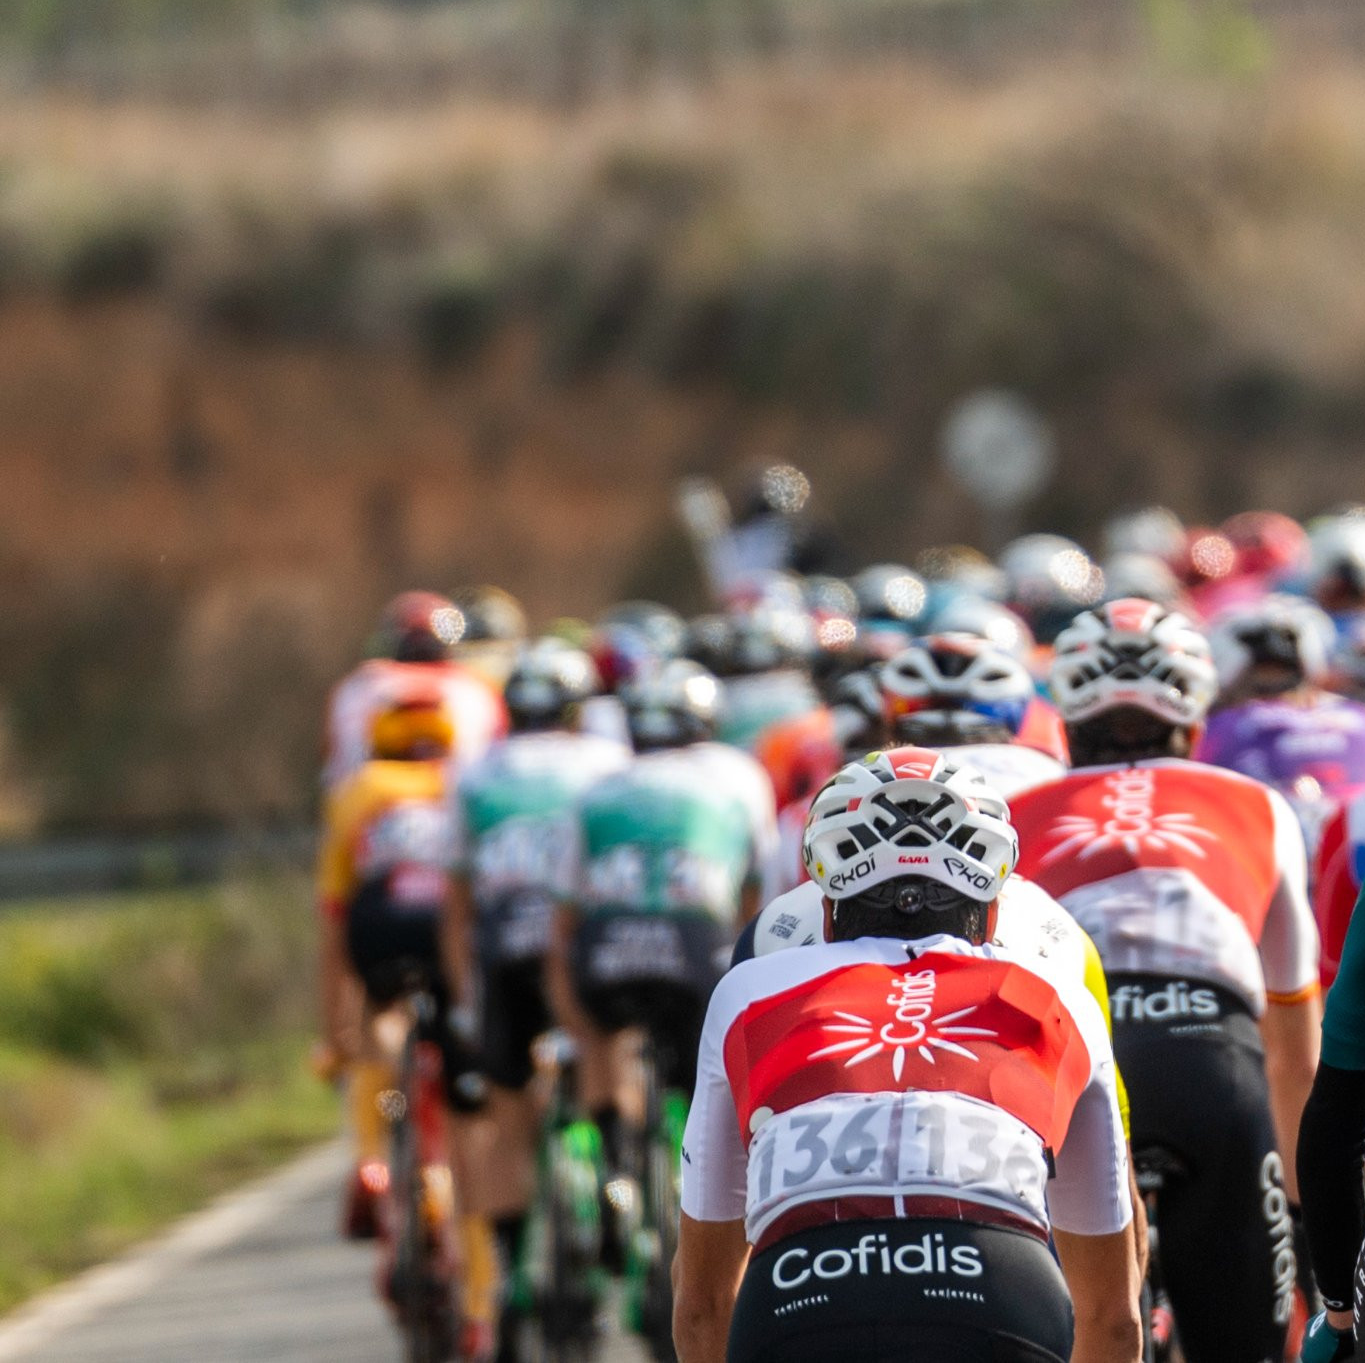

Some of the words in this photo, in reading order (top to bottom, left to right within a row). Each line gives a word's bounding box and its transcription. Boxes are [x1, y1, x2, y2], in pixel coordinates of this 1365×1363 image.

[897, 855, 929, 864] GARA
[880, 969, 937, 1045] Cofidis
[756, 1103, 881, 1203] 136
[772, 1233, 984, 1290] Cofidis
